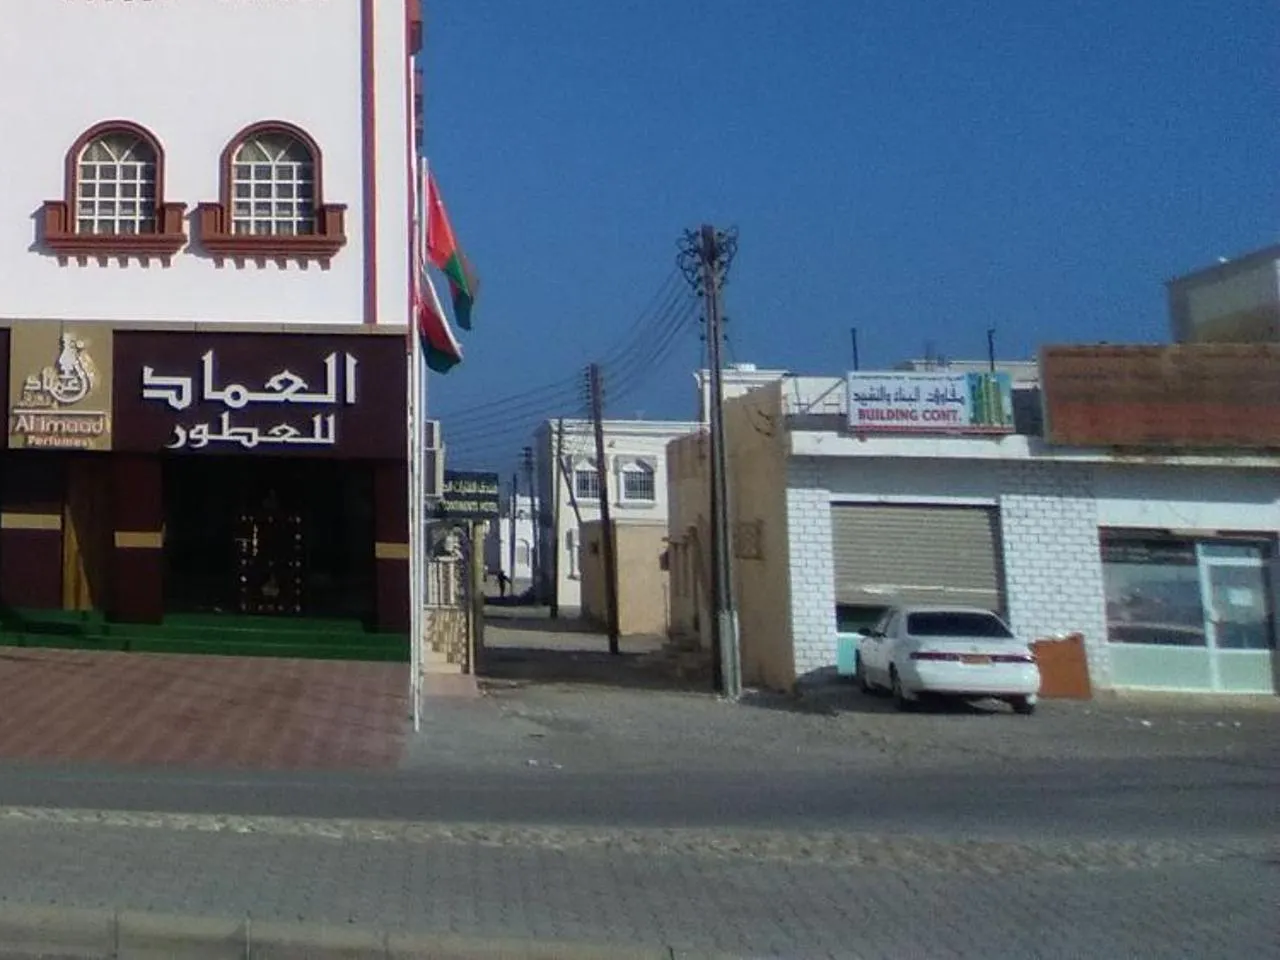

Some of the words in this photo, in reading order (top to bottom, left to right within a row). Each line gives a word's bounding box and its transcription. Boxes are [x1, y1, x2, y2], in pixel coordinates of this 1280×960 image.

[142, 350, 358, 410] العماد
[165, 411, 336, 449] للعطور
[858, 409, 918, 422] BUILDING
